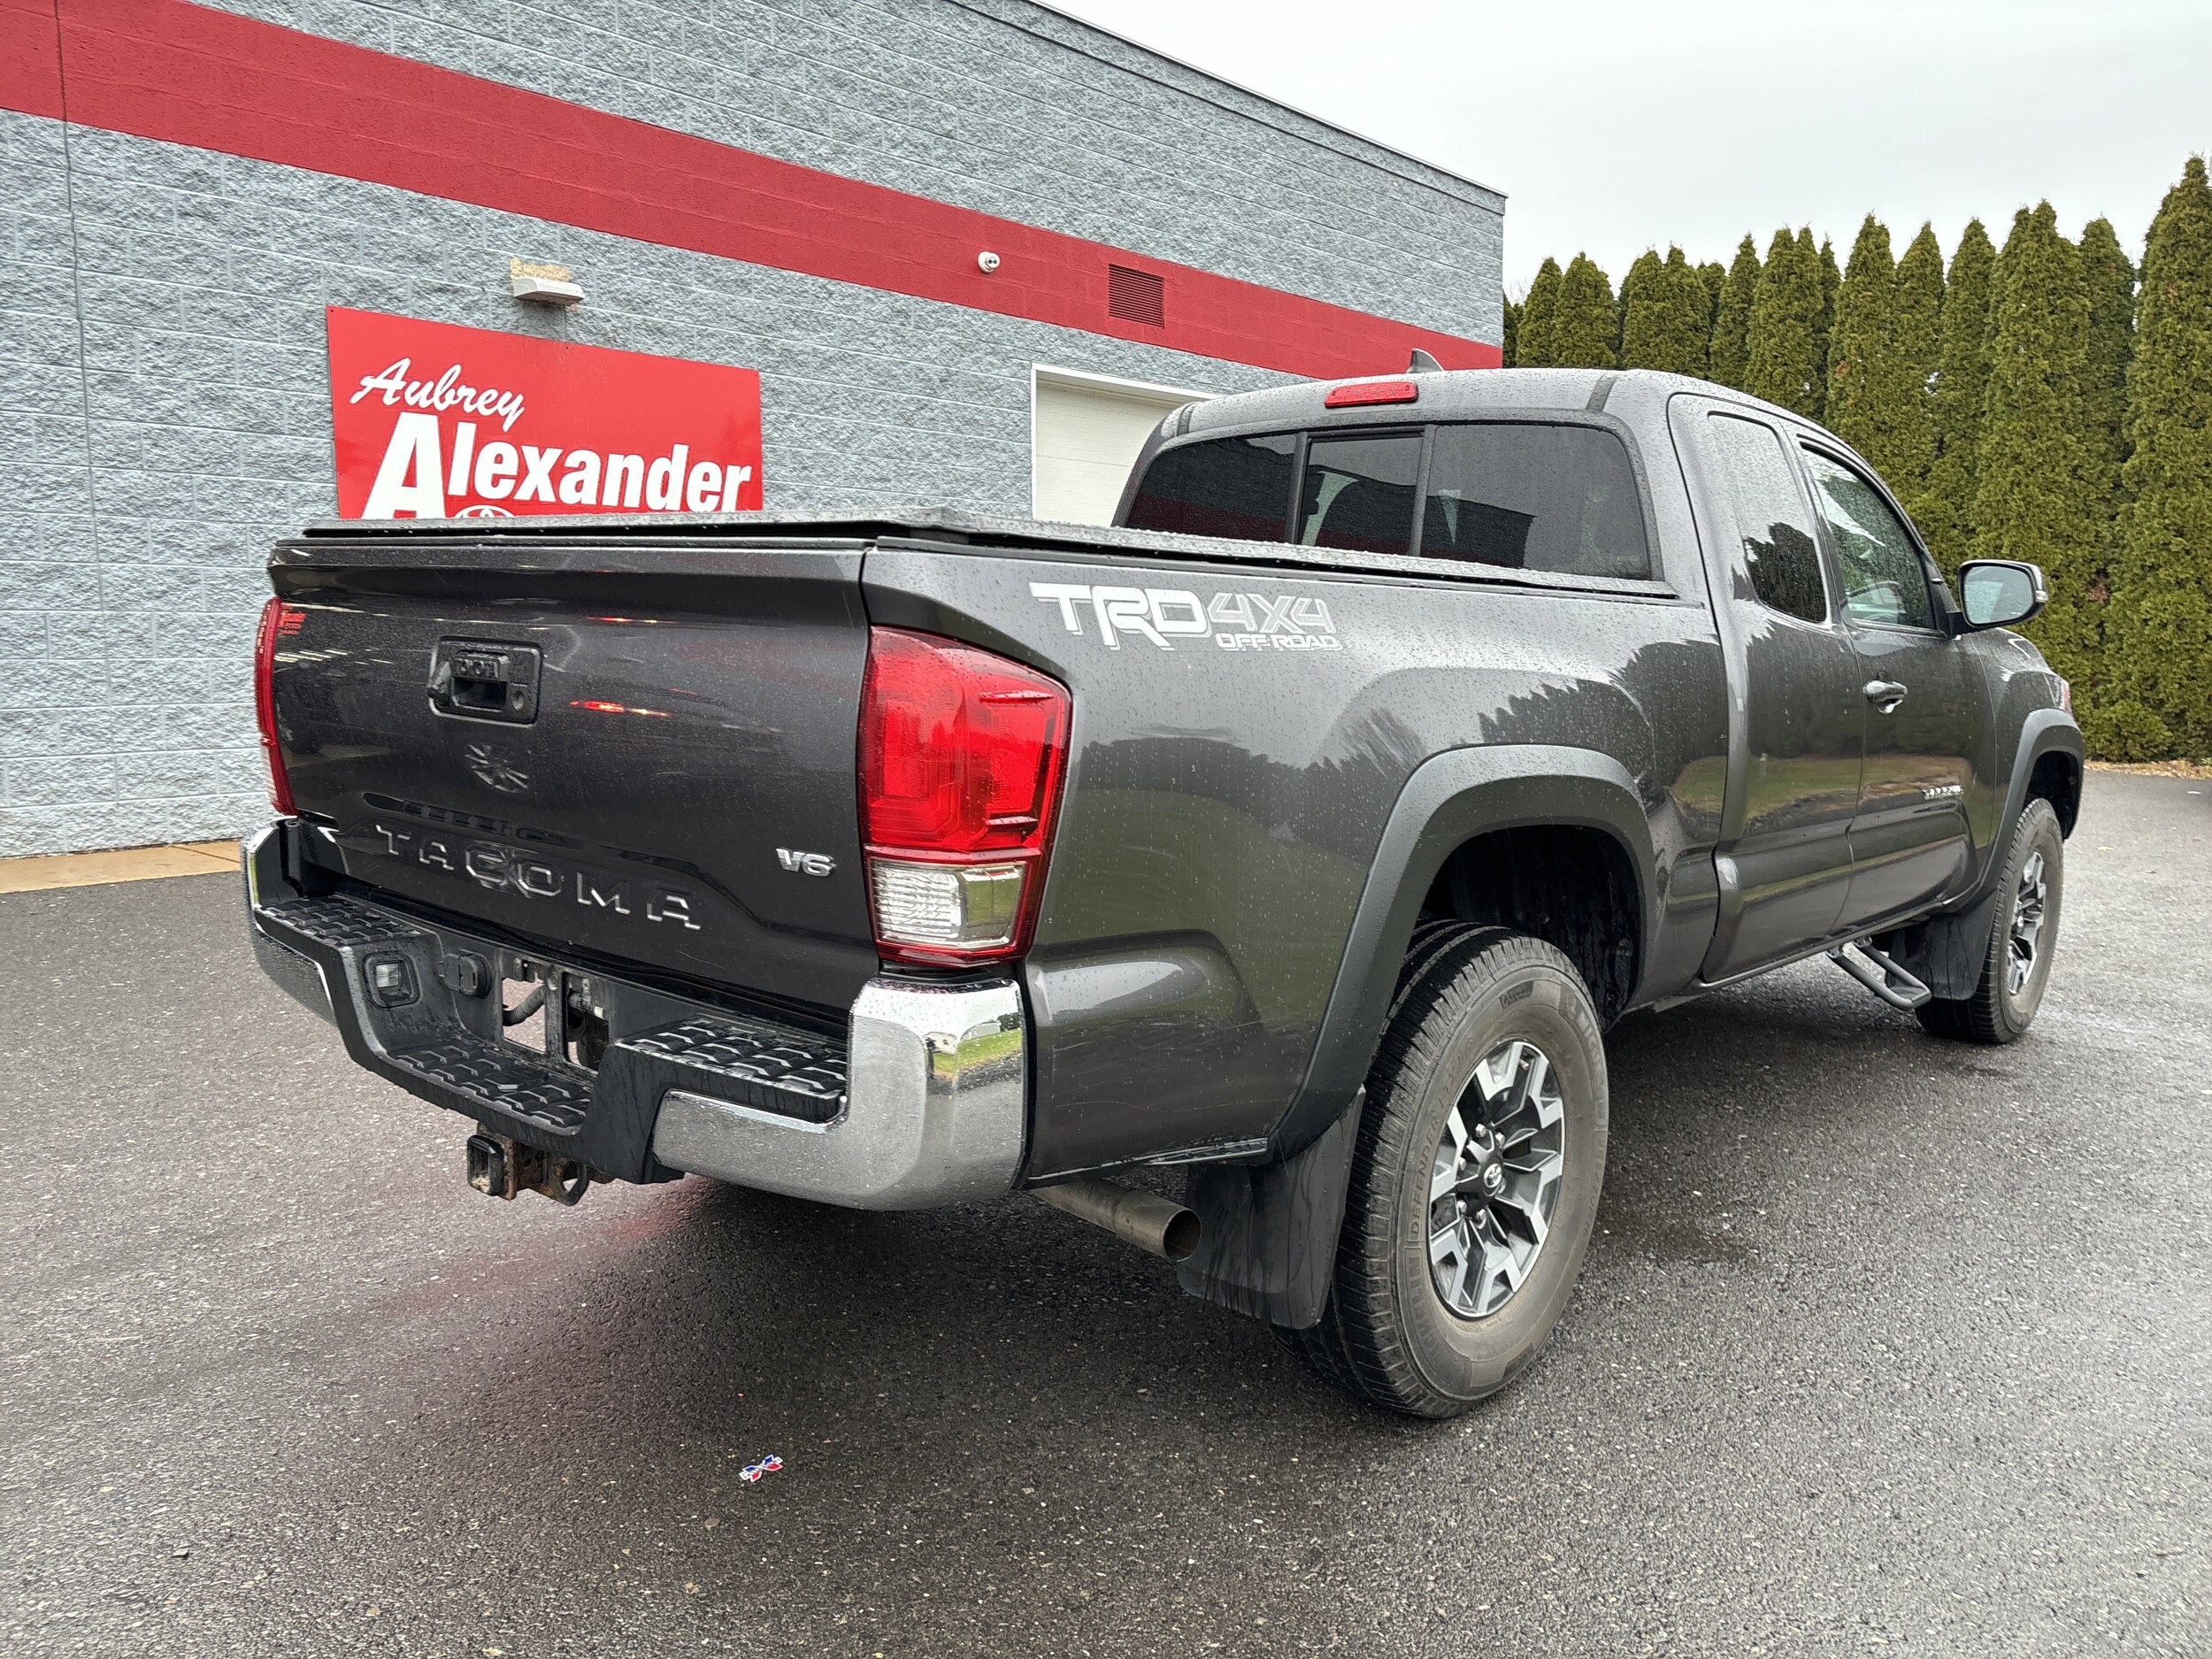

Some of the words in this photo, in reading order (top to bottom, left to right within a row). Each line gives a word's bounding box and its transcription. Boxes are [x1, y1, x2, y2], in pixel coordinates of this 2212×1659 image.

[349, 357, 526, 432] Aubrey
[361, 411, 752, 519] Alexander
[1029, 581, 1211, 650] TRD
[1206, 592, 1337, 634] 4X4
[1215, 633, 1270, 651] OFF
[1270, 634, 1343, 651] ROAD
[376, 824, 702, 931] TACOMA
[776, 847, 836, 878] V6
